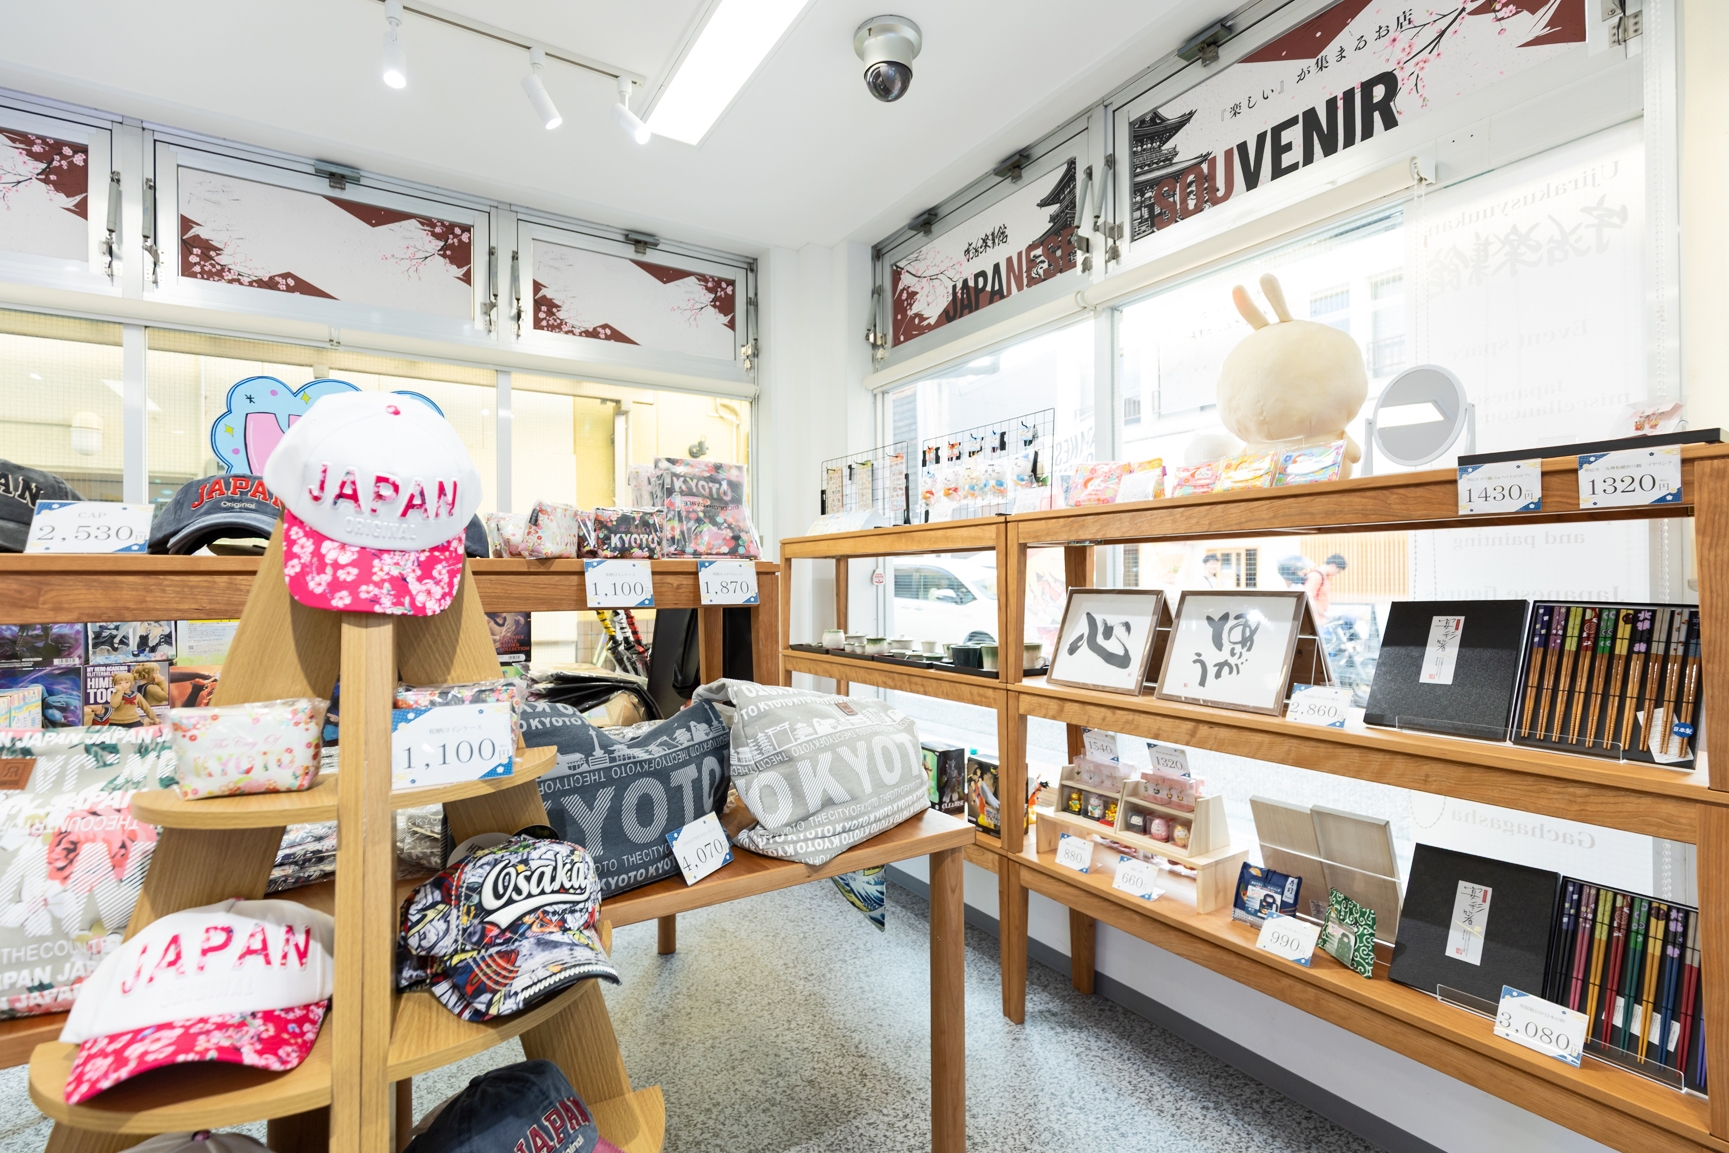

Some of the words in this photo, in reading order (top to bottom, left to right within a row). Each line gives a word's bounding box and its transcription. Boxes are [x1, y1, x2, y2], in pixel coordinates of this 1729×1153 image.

[1154, 71, 1399, 231] SOUVENIR
[944, 224, 1077, 324] JAPANESE
[308, 461, 459, 521] JAPAN
[672, 475, 731, 501] KYOTO
[221, 500, 257, 510] Original
[344, 516, 417, 541] ORIGINAL
[610, 533, 658, 548] KYOTO
[1067, 611, 1132, 669] 心
[530, 716, 582, 730] KYOTO
[1672, 726, 1693, 735] 日本製
[193, 748, 297, 778] KYOTO
[481, 853, 590, 911] Osaka
[121, 922, 311, 995] JAPAN
